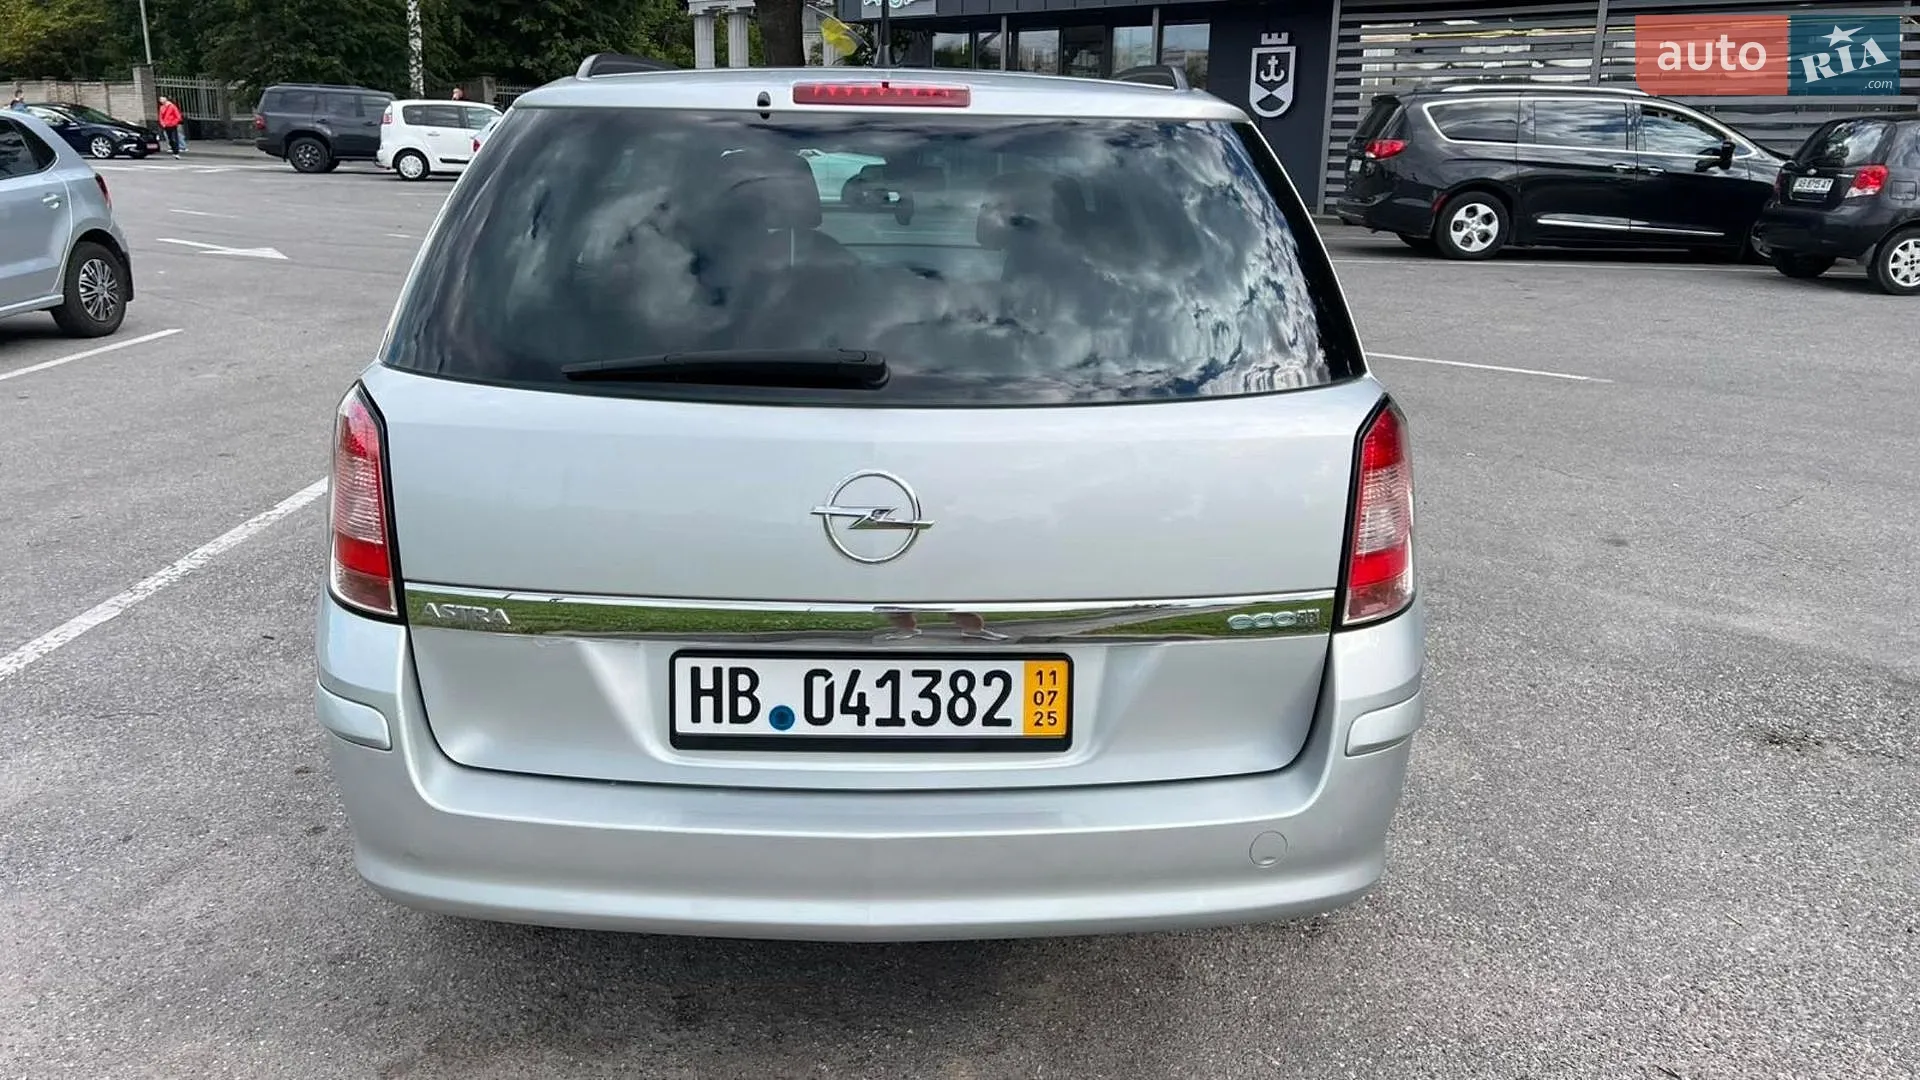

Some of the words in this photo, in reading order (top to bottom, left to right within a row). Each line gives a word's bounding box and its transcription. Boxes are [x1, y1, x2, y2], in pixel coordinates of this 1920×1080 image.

[423, 602, 511, 626] ASTRA
[1035, 669, 1057, 686] 11
[690, 666, 761, 725] HB
[803, 668, 1013, 728] 041382
[1033, 690, 1058, 707] 07
[1033, 710, 1058, 727] 25
